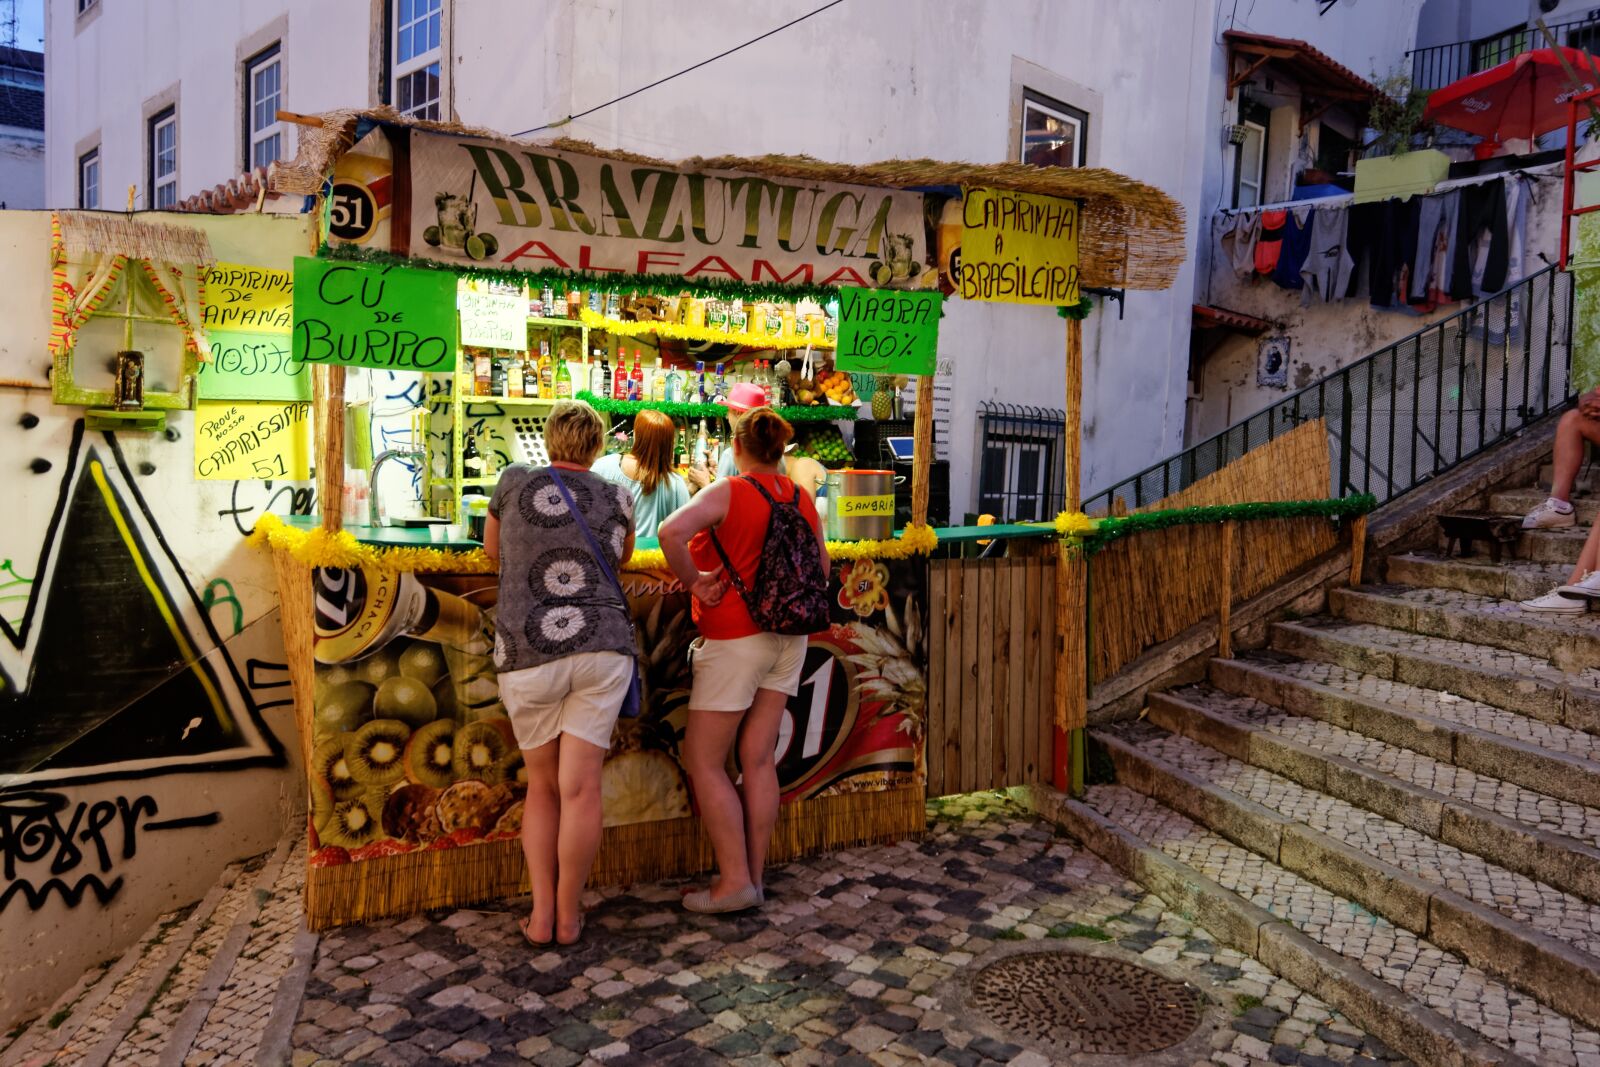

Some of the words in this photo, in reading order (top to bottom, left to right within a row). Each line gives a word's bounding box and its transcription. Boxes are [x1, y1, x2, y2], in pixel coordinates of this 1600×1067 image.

[330, 194, 366, 229] 51
[458, 144, 893, 260] BRAZUTUGA
[962, 188, 1075, 241] CAIPIRINHA
[501, 241, 871, 287] ALFAMA
[960, 257, 1079, 302] BRASILEIRA
[203, 268, 294, 294] AIPIRINH
[221, 288, 253, 303] DE
[318, 266, 393, 308] CÚ
[204, 304, 293, 328] ANANÁ
[373, 311, 404, 324] DE
[296, 318, 448, 368] BURRO
[843, 330, 918, 357] 100%
[200, 406, 237, 439] PROVE
[215, 414, 246, 442] NOSSA
[252, 453, 288, 480] 51
[353, 567, 391, 639] ACHAÇA
[857, 580, 870, 593] 51
